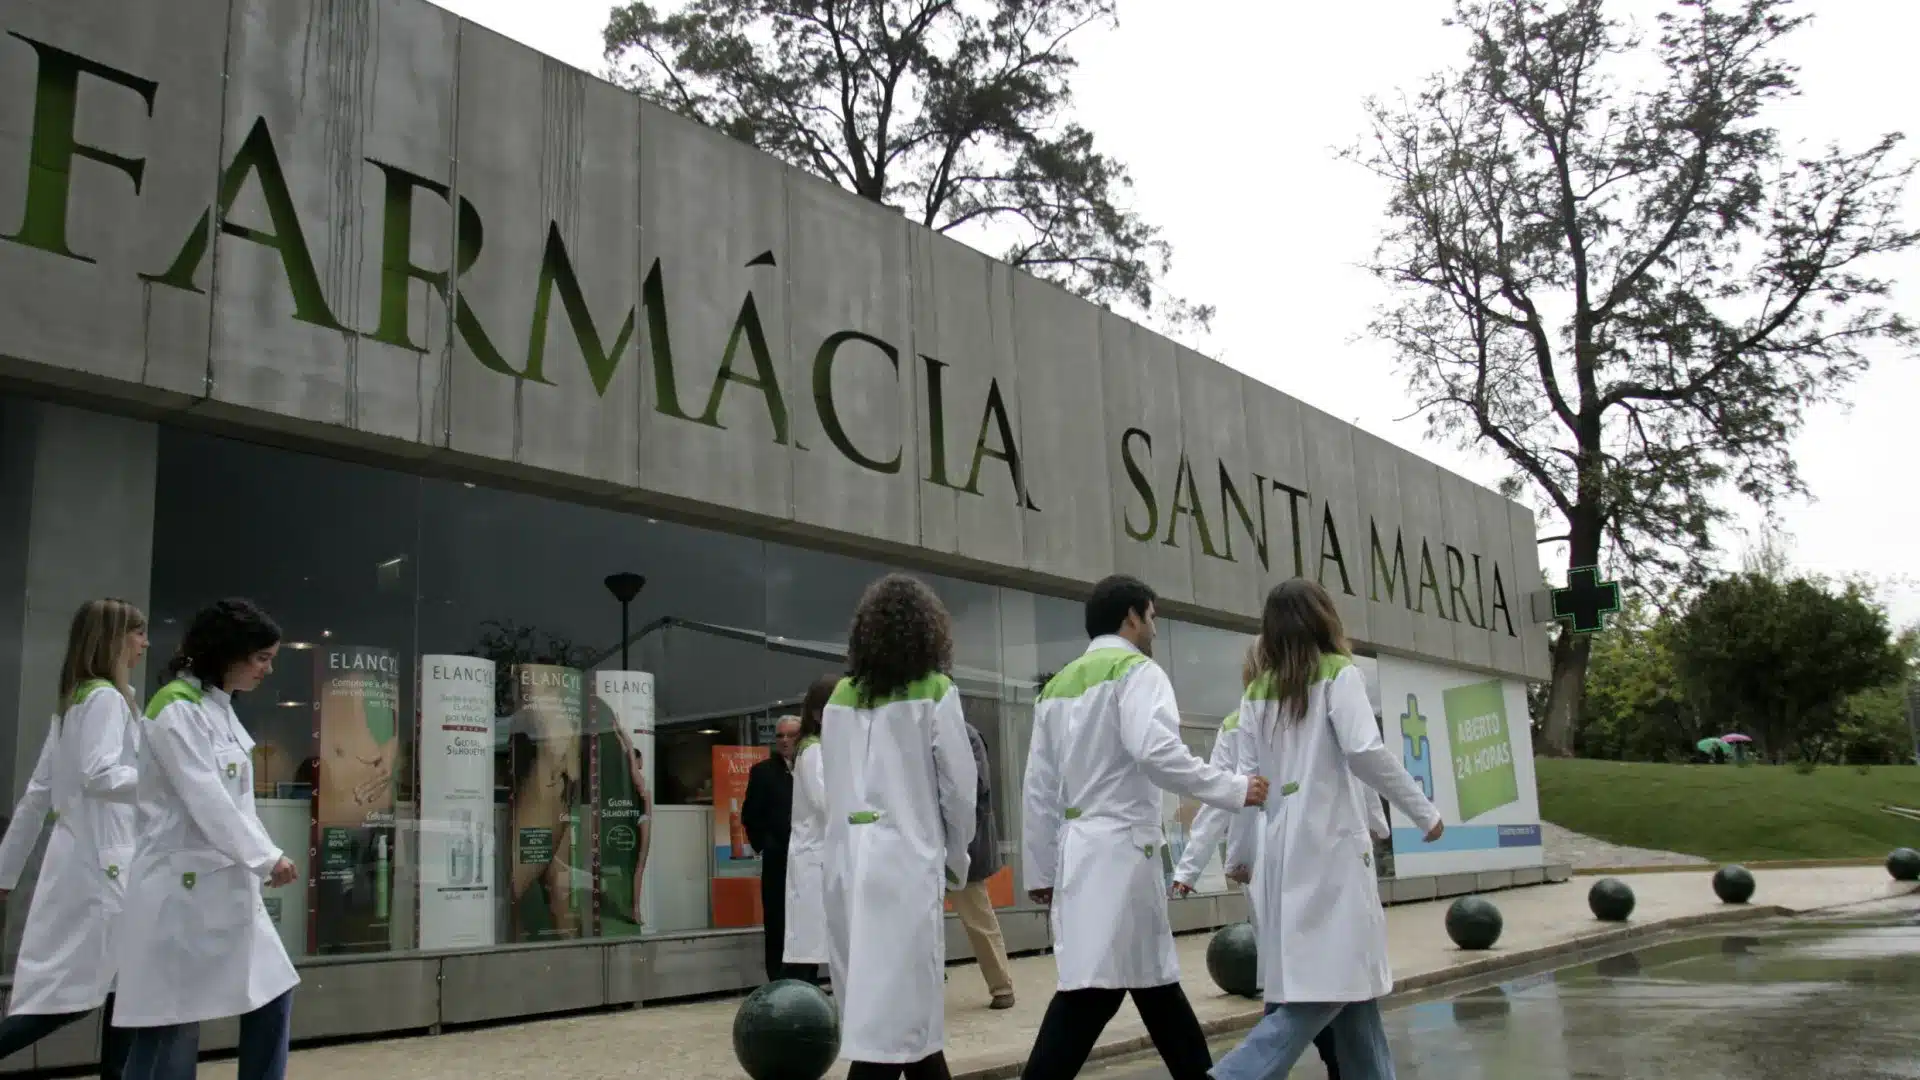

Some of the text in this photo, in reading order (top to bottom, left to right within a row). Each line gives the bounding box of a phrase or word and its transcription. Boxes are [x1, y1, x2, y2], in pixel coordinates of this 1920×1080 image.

[0, 30, 1518, 637] FARMÁCIA SANTA MARIA
[1457, 712, 1500, 744] ABERTO
[1456, 742, 1510, 779] 24 HORAS
